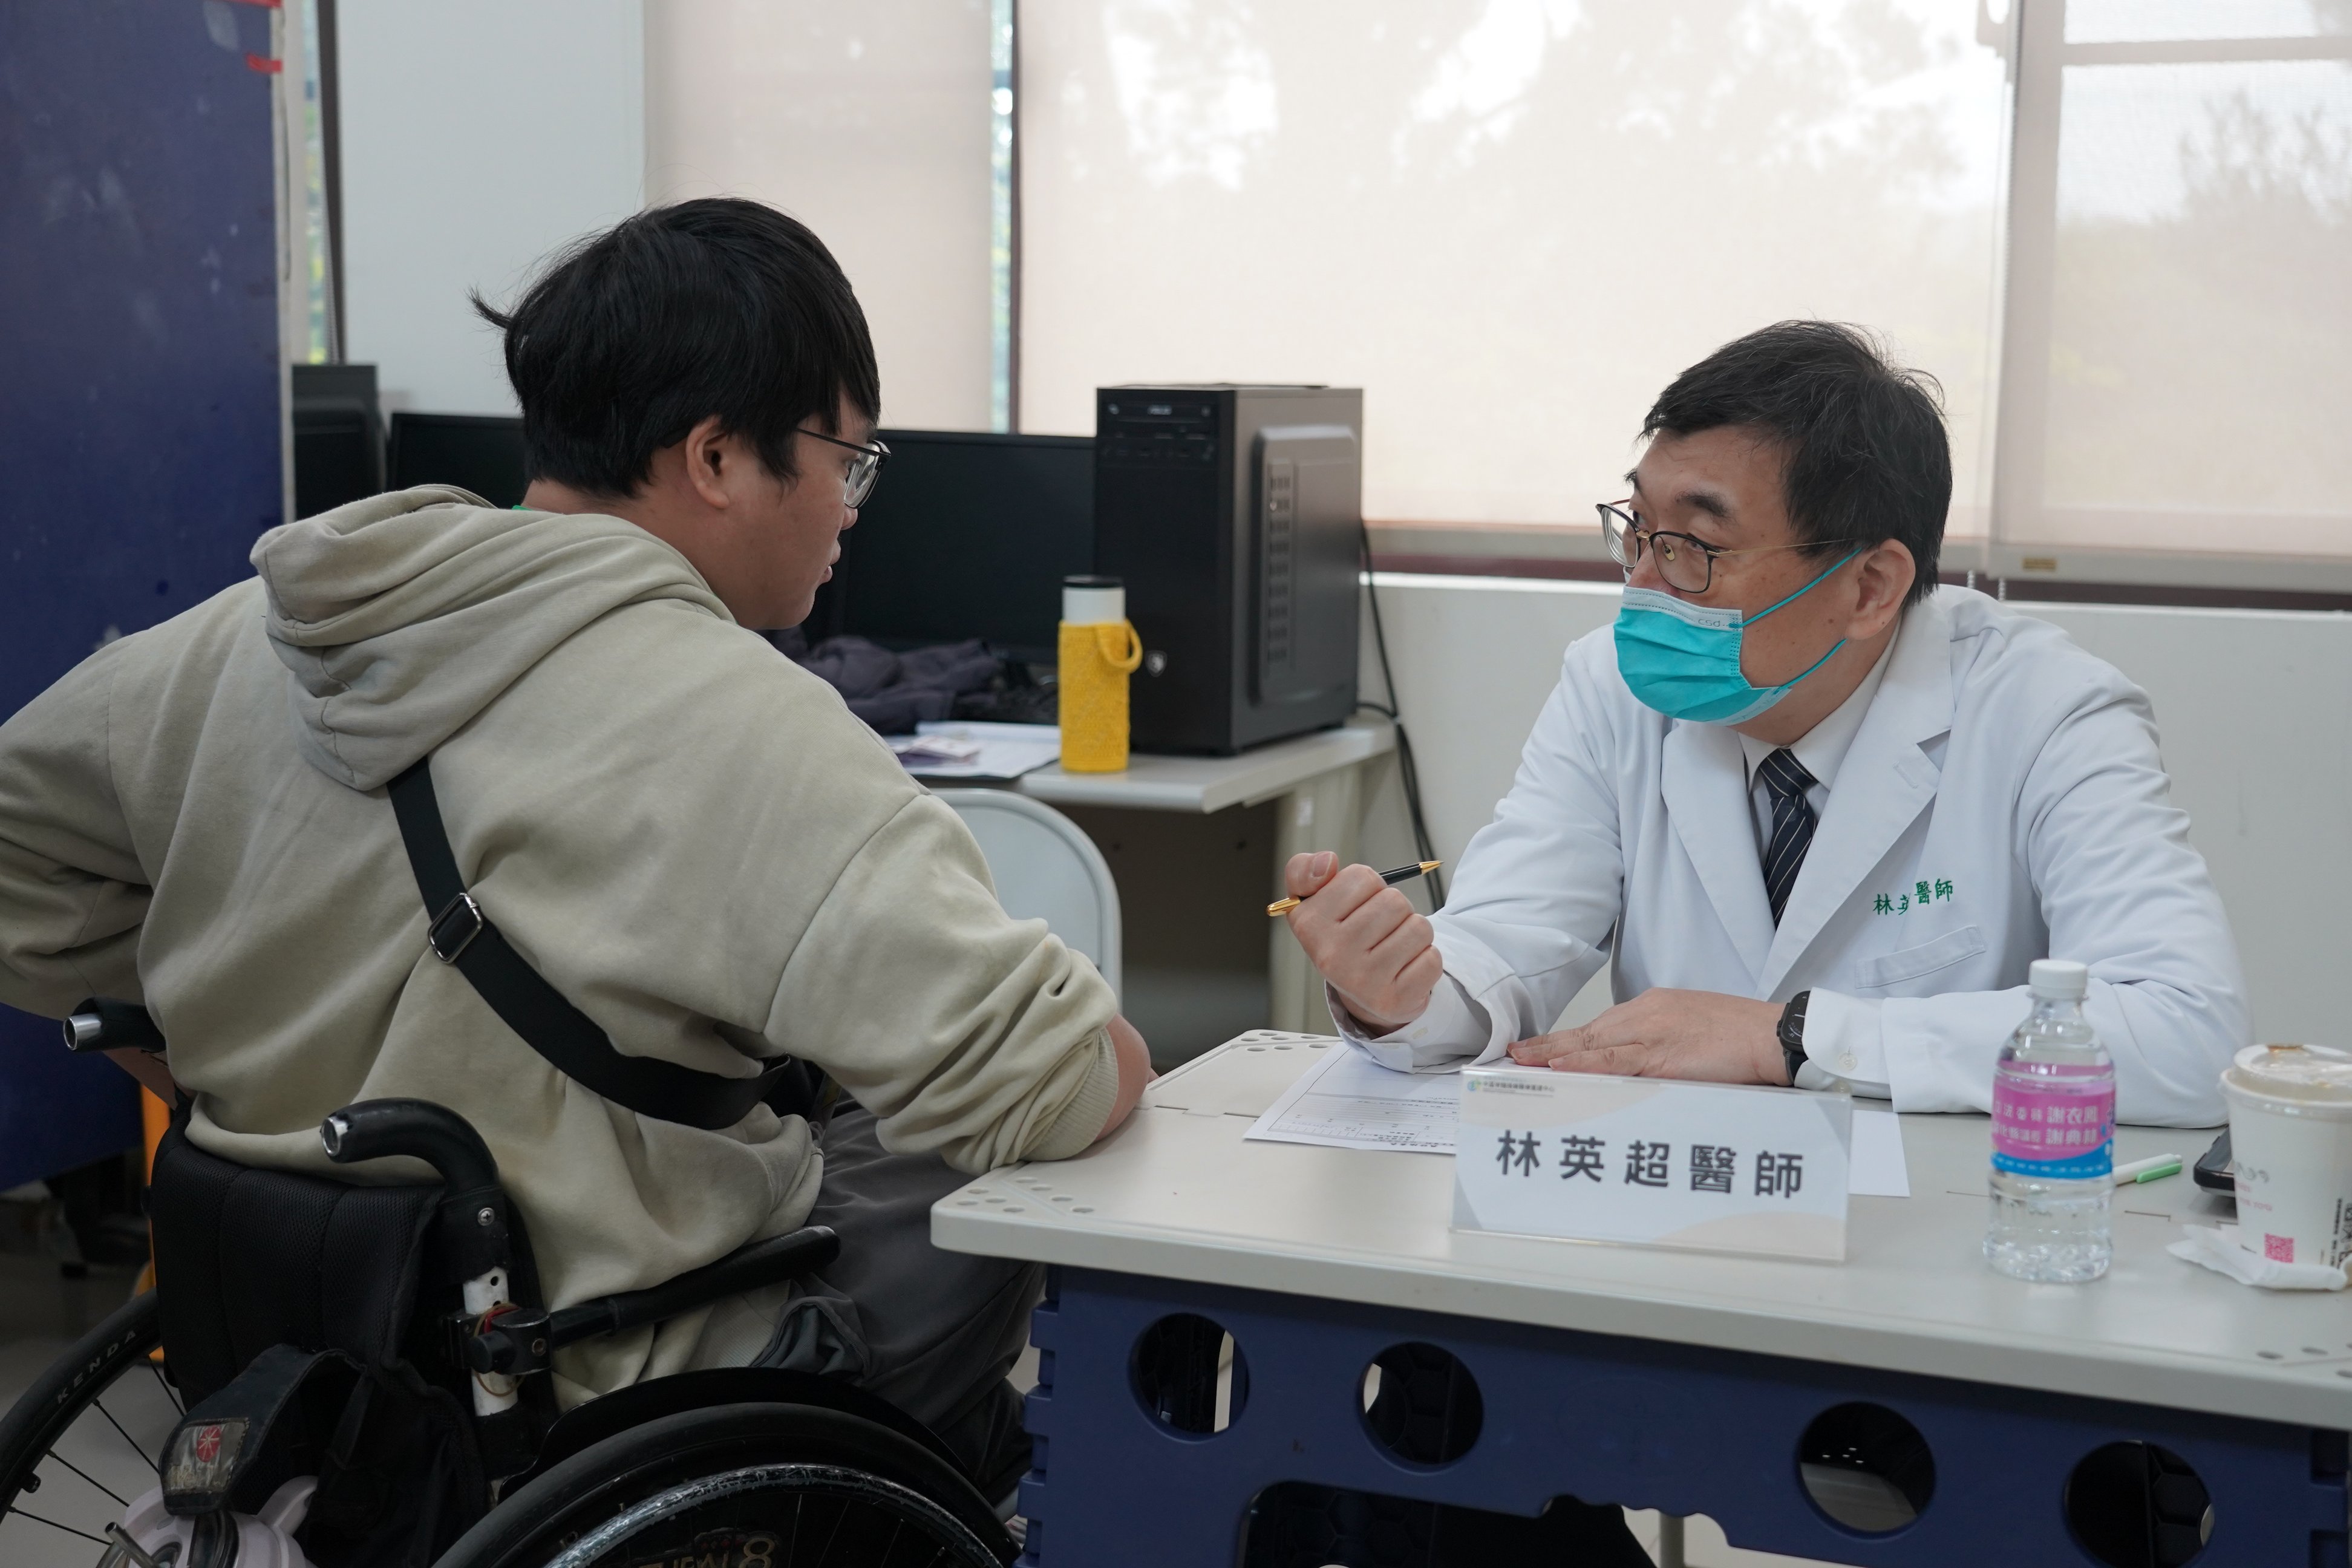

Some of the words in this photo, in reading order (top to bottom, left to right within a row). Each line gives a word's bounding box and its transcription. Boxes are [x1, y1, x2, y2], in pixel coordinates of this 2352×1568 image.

[1872, 878, 1953, 915] 林英醫師
[1495, 1129, 1804, 1199] 林英超醫師
[57, 1330, 136, 1404] KENDA
